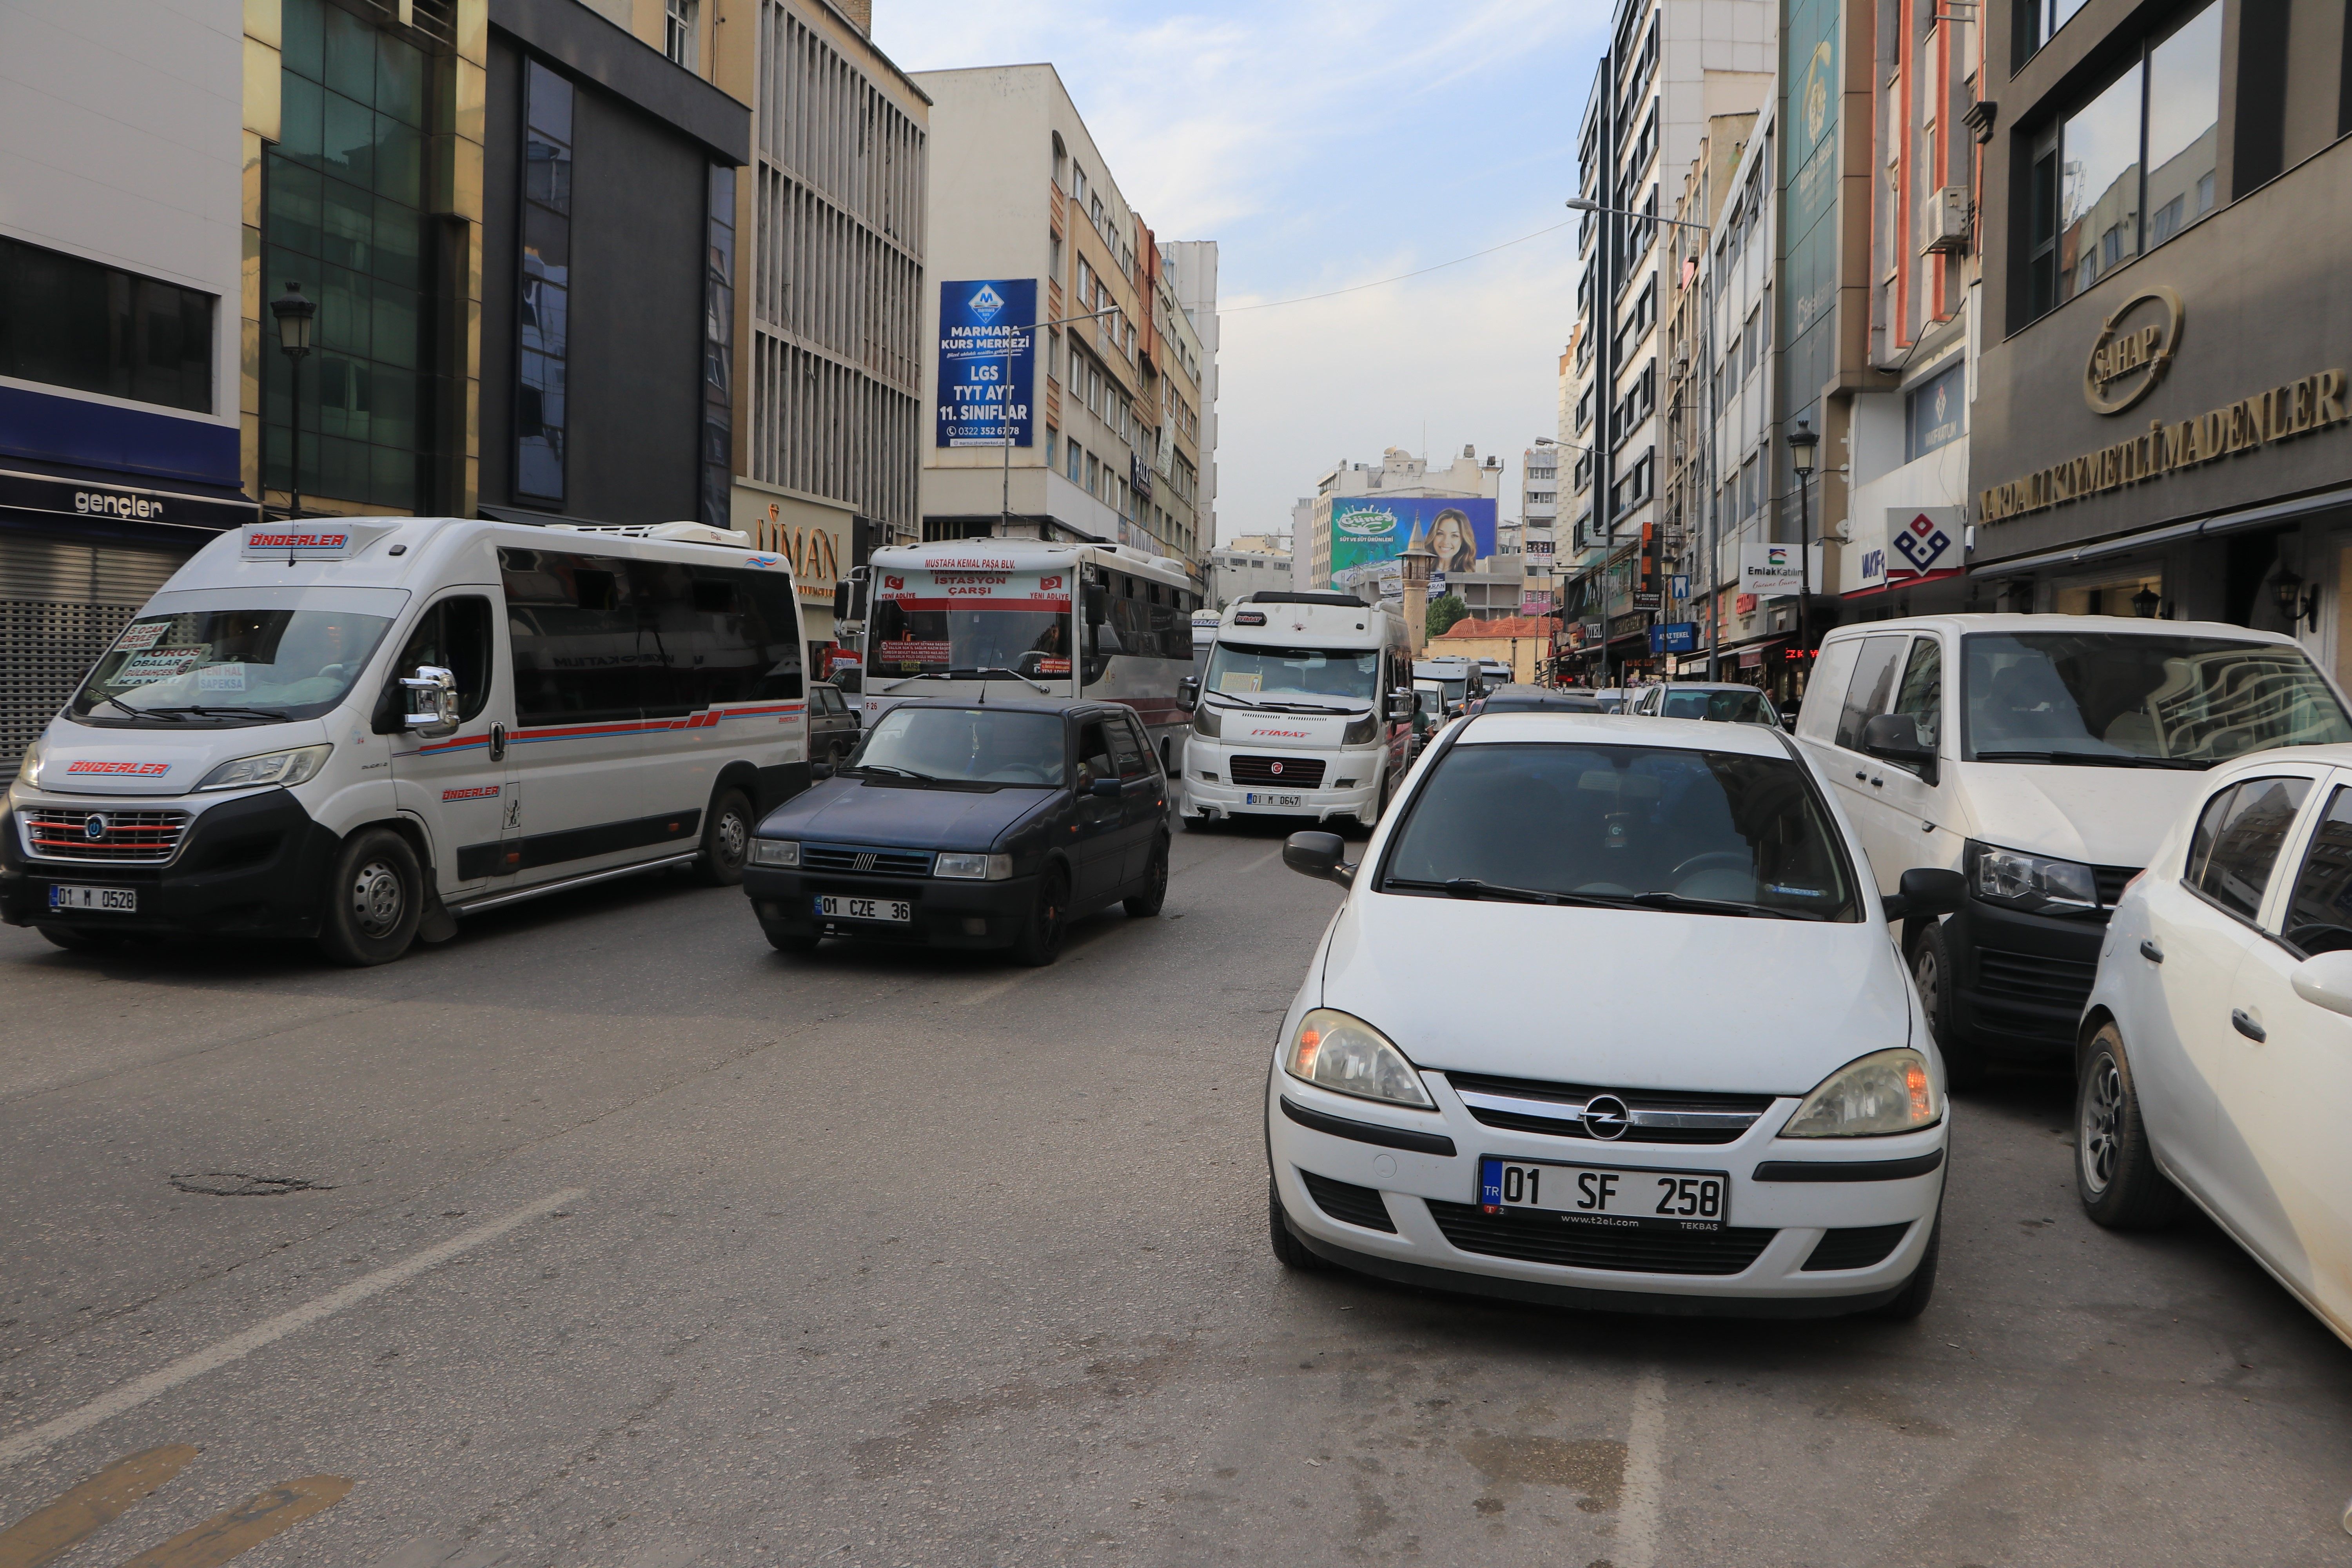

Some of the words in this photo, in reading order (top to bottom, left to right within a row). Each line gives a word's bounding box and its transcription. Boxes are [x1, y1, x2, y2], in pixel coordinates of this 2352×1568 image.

[951, 325, 1020, 337] MARMARA
[941, 339, 973, 349] KURS
[976, 335, 1029, 348] MERKEZİ
[2095, 325, 2161, 394] ŞAHAP
[971, 366, 998, 381] LGS
[954, 386, 982, 400] TYT
[985, 385, 1014, 400] AYT
[940, 406, 956, 421] 11.
[960, 405, 1027, 420] SINIFLAR
[958, 427, 978, 435] 0322
[980, 427, 995, 435] 352
[997, 426, 1006, 435] 67
[1009, 426, 1019, 435] 78
[2052, 419, 2162, 504] KIYMETLİ
[2162, 368, 2346, 471] MADENLER
[1925, 429, 1938, 448] VAKIF
[75, 491, 163, 519] gençler
[1341, 514, 1394, 525] Güney
[249, 533, 347, 548] ÖNDERLER
[925, 559, 955, 568] MUSTAFA
[957, 559, 980, 568] KEMAL
[982, 559, 999, 571] PAŞA
[1001, 560, 1015, 569] BLV.
[1862, 549, 1881, 578] VAKIF
[1748, 566, 1804, 577] EmlakKatılım
[935, 576, 1006, 584] İSTASYON
[895, 591, 916, 599] ADLİYE
[948, 587, 992, 595] ÇARŞI
[1030, 591, 1045, 600] YENİ
[1046, 592, 1069, 601] ADLİYE
[1586, 623, 1602, 639] OTEL
[122, 633, 159, 643] DEVLET
[141, 648, 201, 657] TOROS
[200, 665, 221, 676] YENİ
[224, 666, 243, 676] HAL
[200, 679, 243, 689] SAPEKSA
[870, 702, 877, 710] 26
[67, 760, 172, 778] ÖNDERLER
[442, 785, 500, 803] ÖNDERLER
[1252, 795, 1261, 804] 01
[1268, 796, 1273, 804] M
[1280, 796, 1299, 806] 0647
[59, 887, 73, 906] 01
[84, 890, 91, 906] M
[102, 891, 134, 909] 0528
[822, 897, 837, 915] 01
[849, 899, 875, 918] CZE
[891, 902, 909, 920] 36
[1484, 1185, 1499, 1197] TR
[1504, 1166, 1540, 1205] 01
[1577, 1172, 1619, 1210] SF
[1655, 1178, 1720, 1217] 258
[1561, 1215, 1639, 1227] www.t2el.com
[1681, 1221, 1718, 1231] TEKBAŞ
